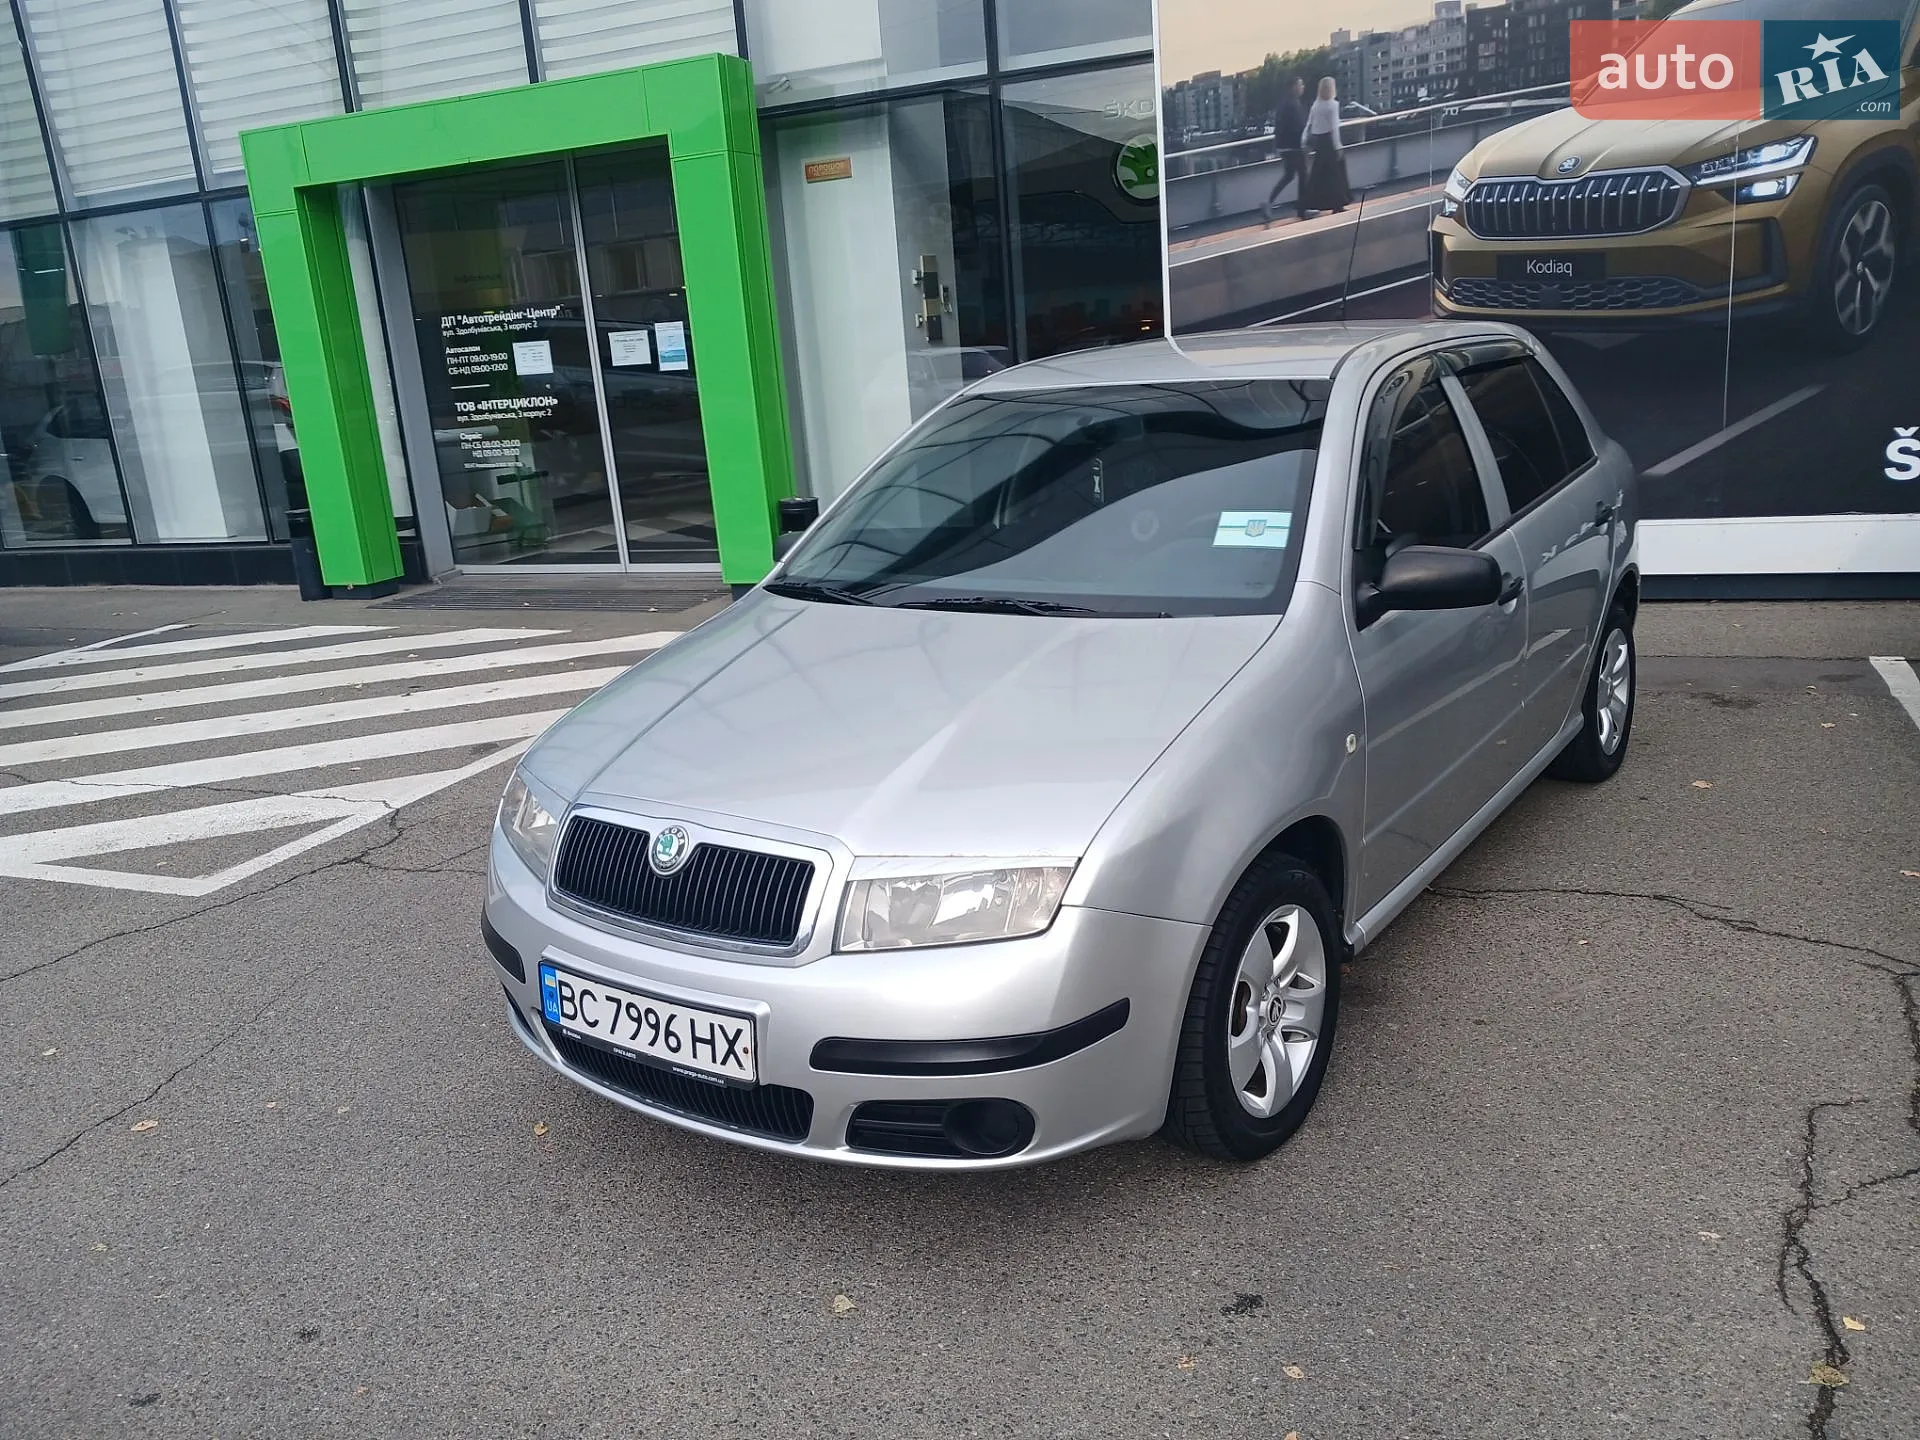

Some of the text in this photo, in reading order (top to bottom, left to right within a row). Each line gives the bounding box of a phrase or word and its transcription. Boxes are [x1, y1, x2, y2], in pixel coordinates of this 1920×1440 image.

[1526, 259, 1573, 277] Kodiaq
[441, 315, 456, 328] ДП
[457, 305, 560, 325] "Автотрейдінг-Центр"
[503, 323, 509, 331] 3
[533, 320, 538, 328] 2
[455, 396, 559, 412] ТОВ «ІНТЕРЦИКЛОН»
[547, 408, 552, 416] 2
[1884, 426, 1920, 480] Š
[546, 999, 559, 1015] UA
